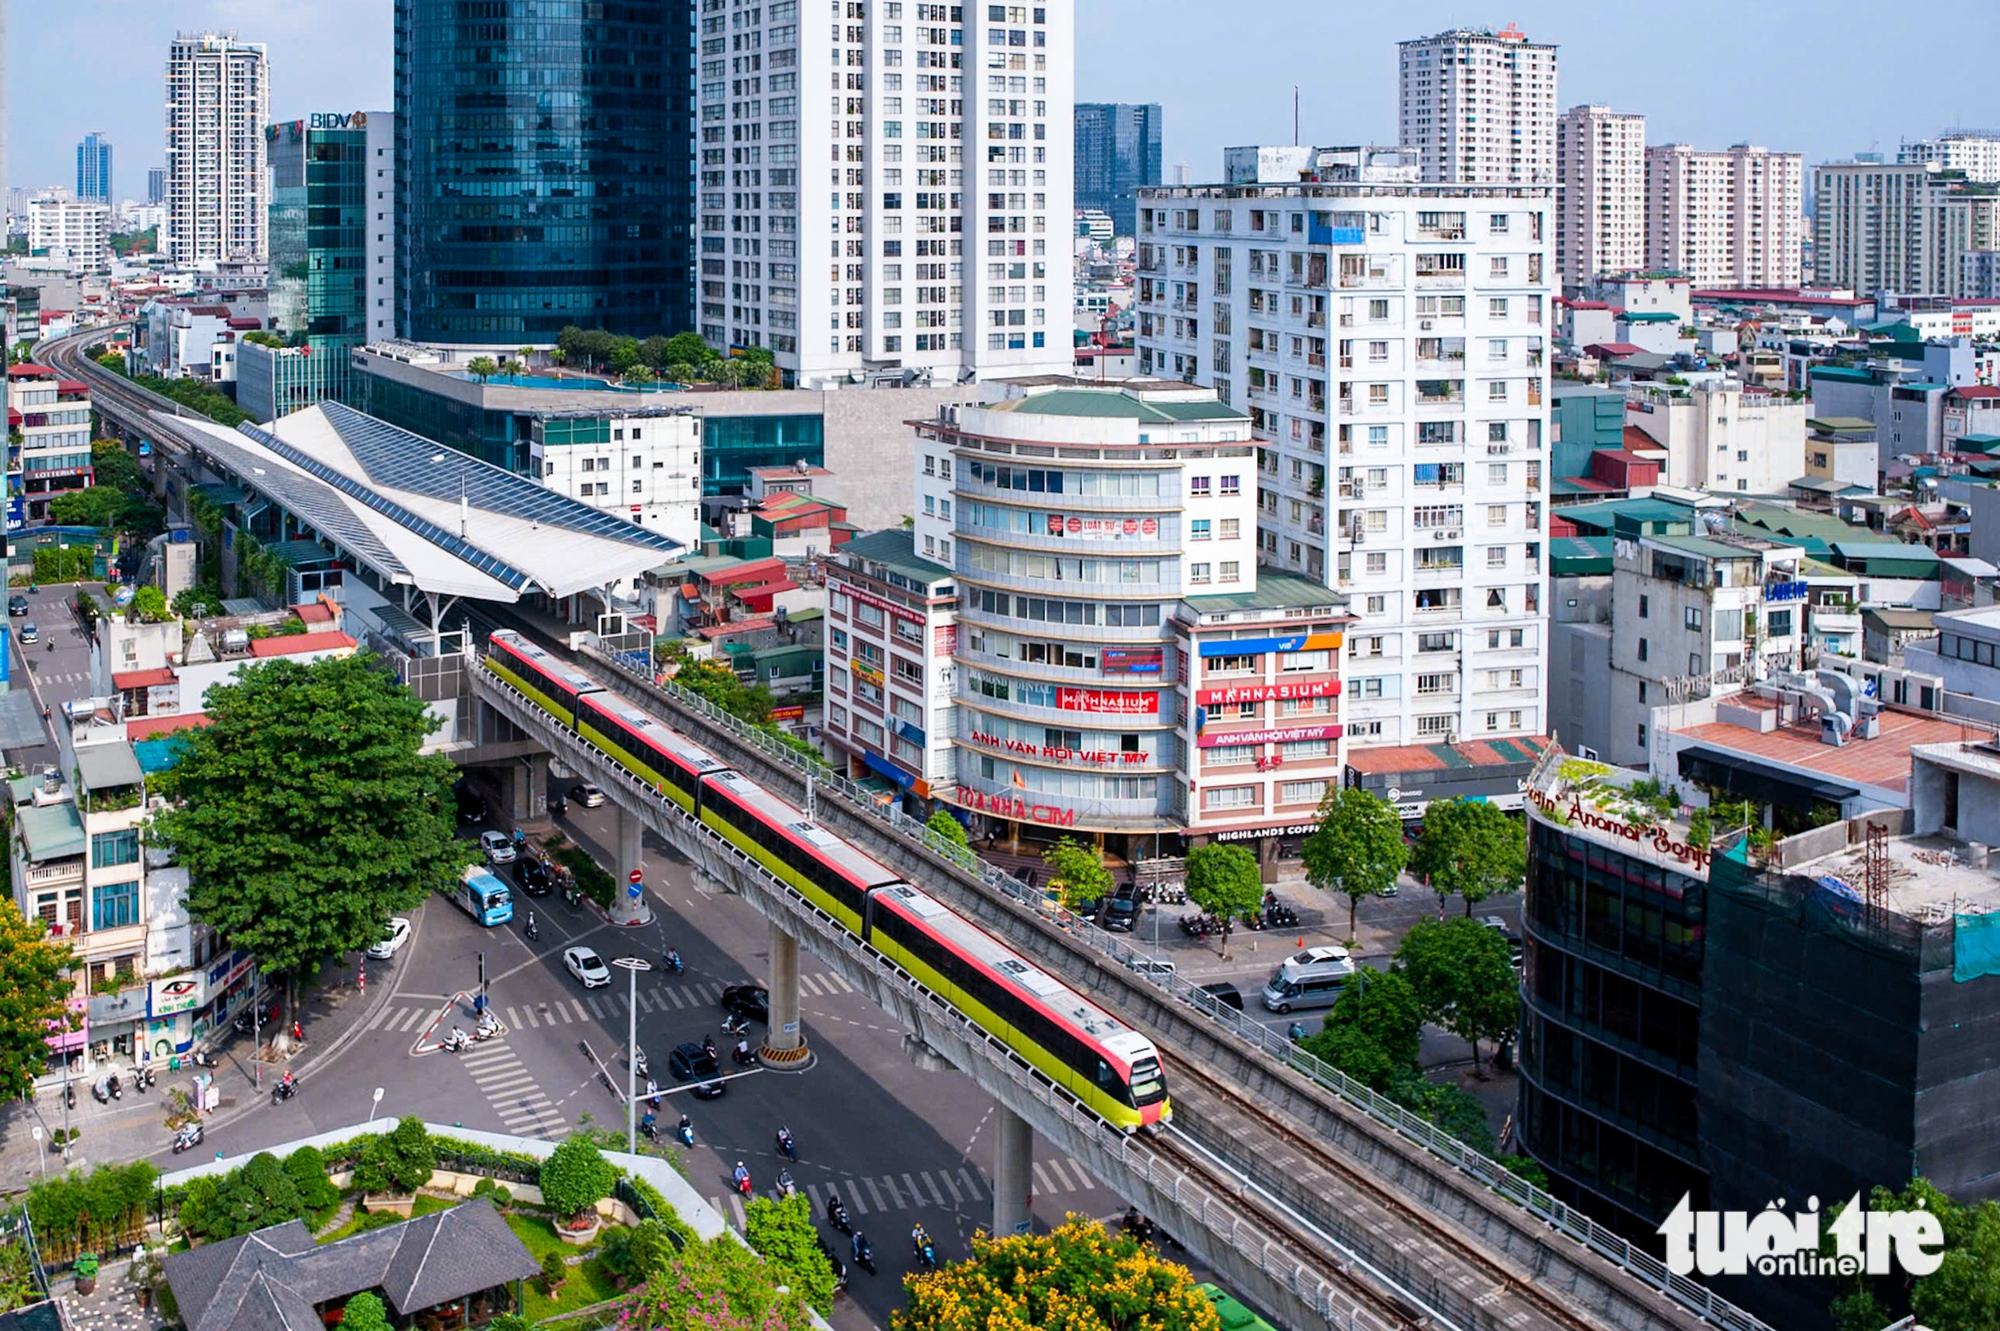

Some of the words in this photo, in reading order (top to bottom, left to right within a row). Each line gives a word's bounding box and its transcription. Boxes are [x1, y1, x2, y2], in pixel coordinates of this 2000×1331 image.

[311, 113, 351, 128] BIDV
[280, 347, 300, 356] BIC
[35, 470, 75, 478] LOTTERIA
[1278, 642, 1291, 650] VIB
[1216, 735, 1240, 744] ANH
[972, 730, 999, 747] ANH
[1043, 745, 1072, 762] HỘI
[956, 785, 986, 811] TÒA
[990, 796, 1027, 819] NHÀ
[1032, 805, 1074, 826] CTM
[1218, 827, 1284, 841] HIGHLANDS
